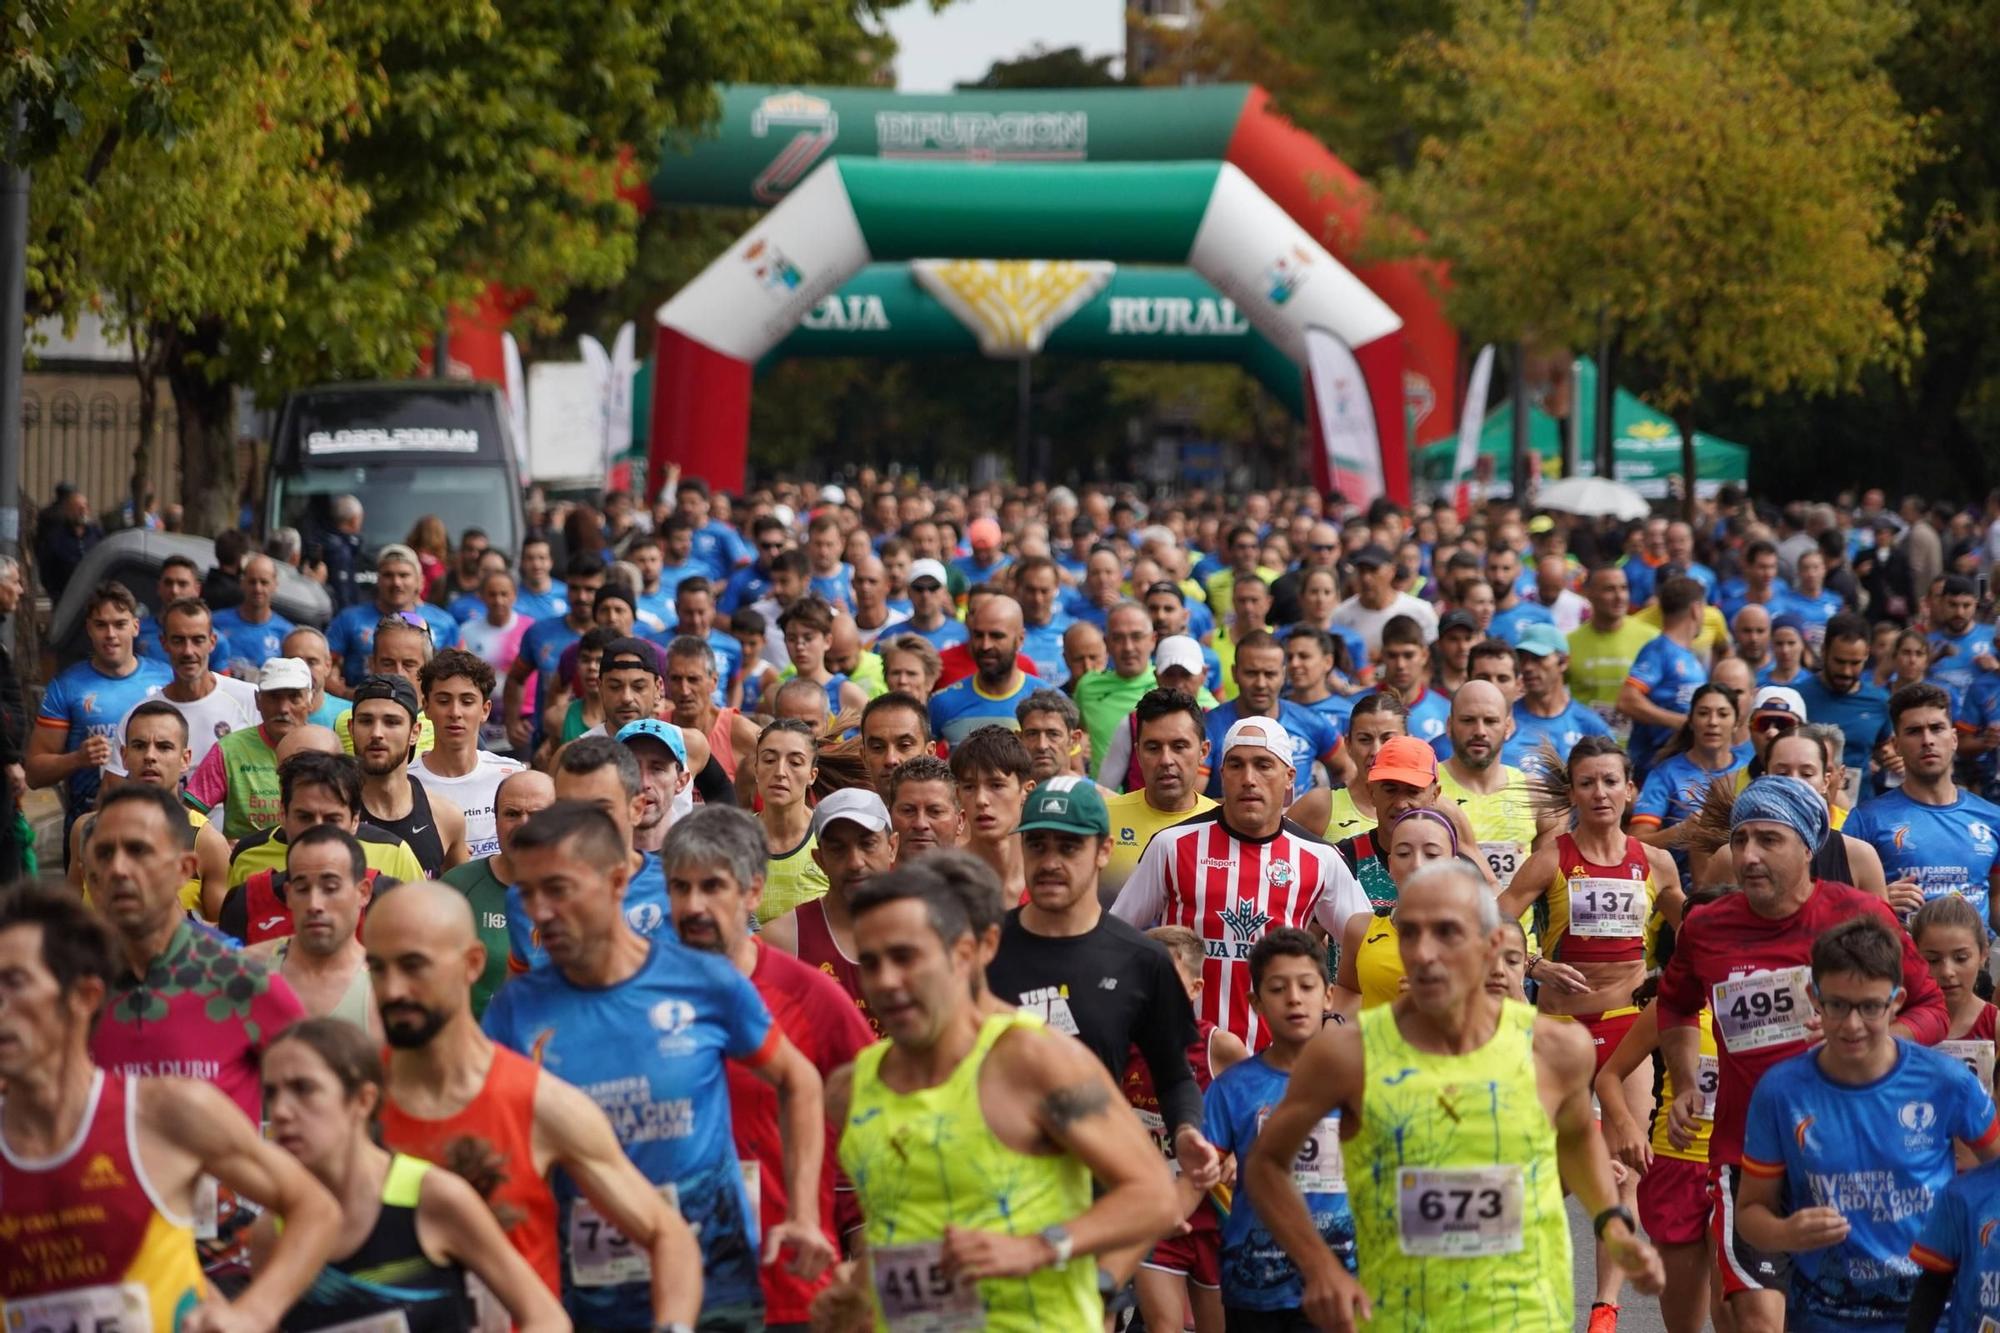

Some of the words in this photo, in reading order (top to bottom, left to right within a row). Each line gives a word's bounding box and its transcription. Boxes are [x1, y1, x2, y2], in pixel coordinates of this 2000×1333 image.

[802, 295, 890, 331] CAJA
[1109, 297, 1249, 334] RURAL
[1200, 858, 1237, 868] uhlsport
[1927, 866, 1968, 875] CARRERA
[1585, 891, 1634, 913] 137
[1730, 987, 1794, 1021] 495
[1739, 1019, 1767, 1031] MIGUEL
[1768, 1015, 1791, 1025] ANGEL
[1838, 1170, 1894, 1182] CARRERA
[1839, 1180, 1895, 1194] POPULAR
[1418, 1189, 1503, 1221] 673
[1872, 1195, 1934, 1222] ZAMORA
[884, 1264, 955, 1301] 415
